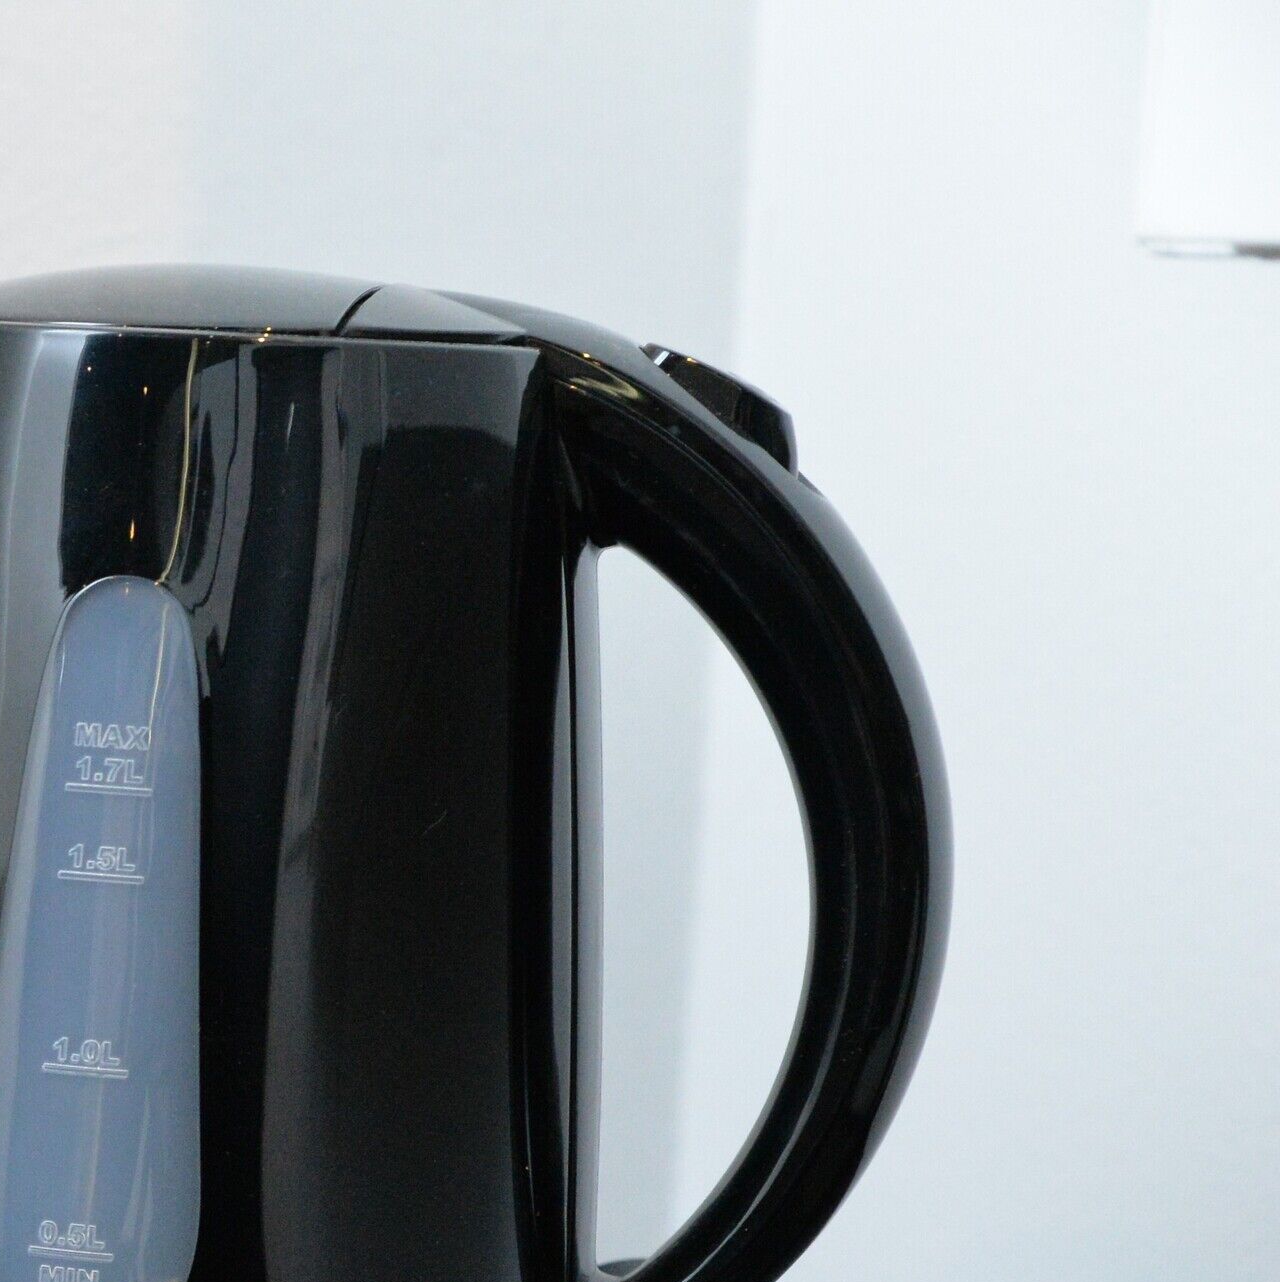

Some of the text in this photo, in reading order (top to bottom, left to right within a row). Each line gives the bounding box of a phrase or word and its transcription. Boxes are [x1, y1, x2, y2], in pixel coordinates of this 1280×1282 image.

[74, 722, 149, 750] MAX
[76, 756, 144, 783] 1.7L
[68, 844, 136, 872] 1.5L
[52, 1036, 121, 1066] 1.0L
